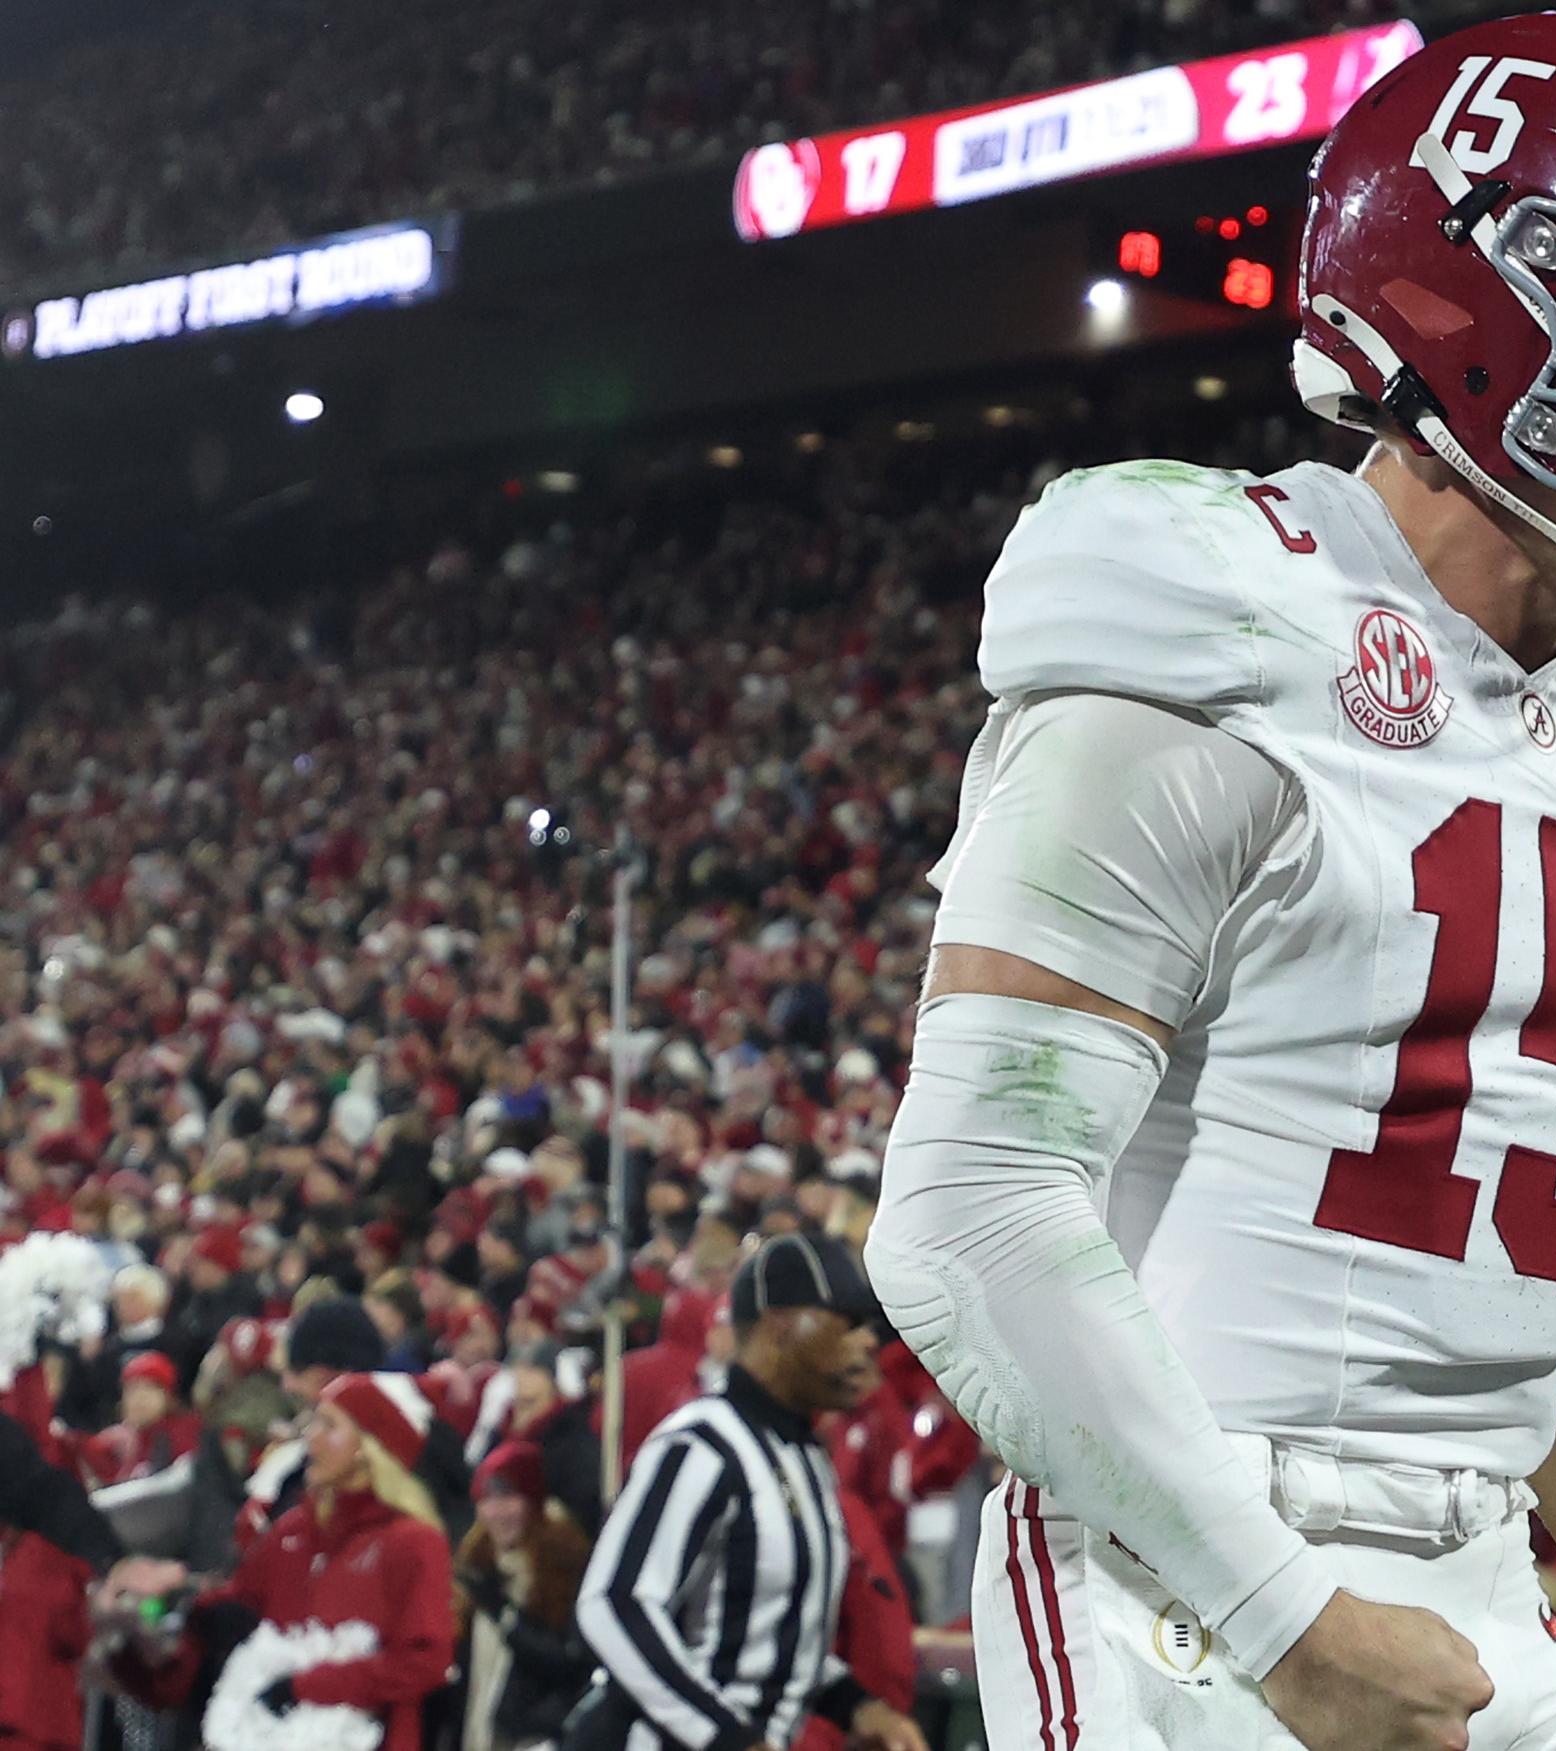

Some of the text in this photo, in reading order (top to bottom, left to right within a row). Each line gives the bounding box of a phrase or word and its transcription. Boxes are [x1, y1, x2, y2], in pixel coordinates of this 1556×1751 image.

[841, 131, 906, 215] 17
[1222, 52, 1308, 145] 23
[34, 229, 432, 359] PLAYOFF FIRST ROUND
[1432, 431, 1506, 501] CRIMSON
[1243, 483, 1318, 554] C
[1361, 610, 1432, 709] SEC
[1350, 695, 1441, 744] GRADUATE
[1528, 701, 1549, 736] A
